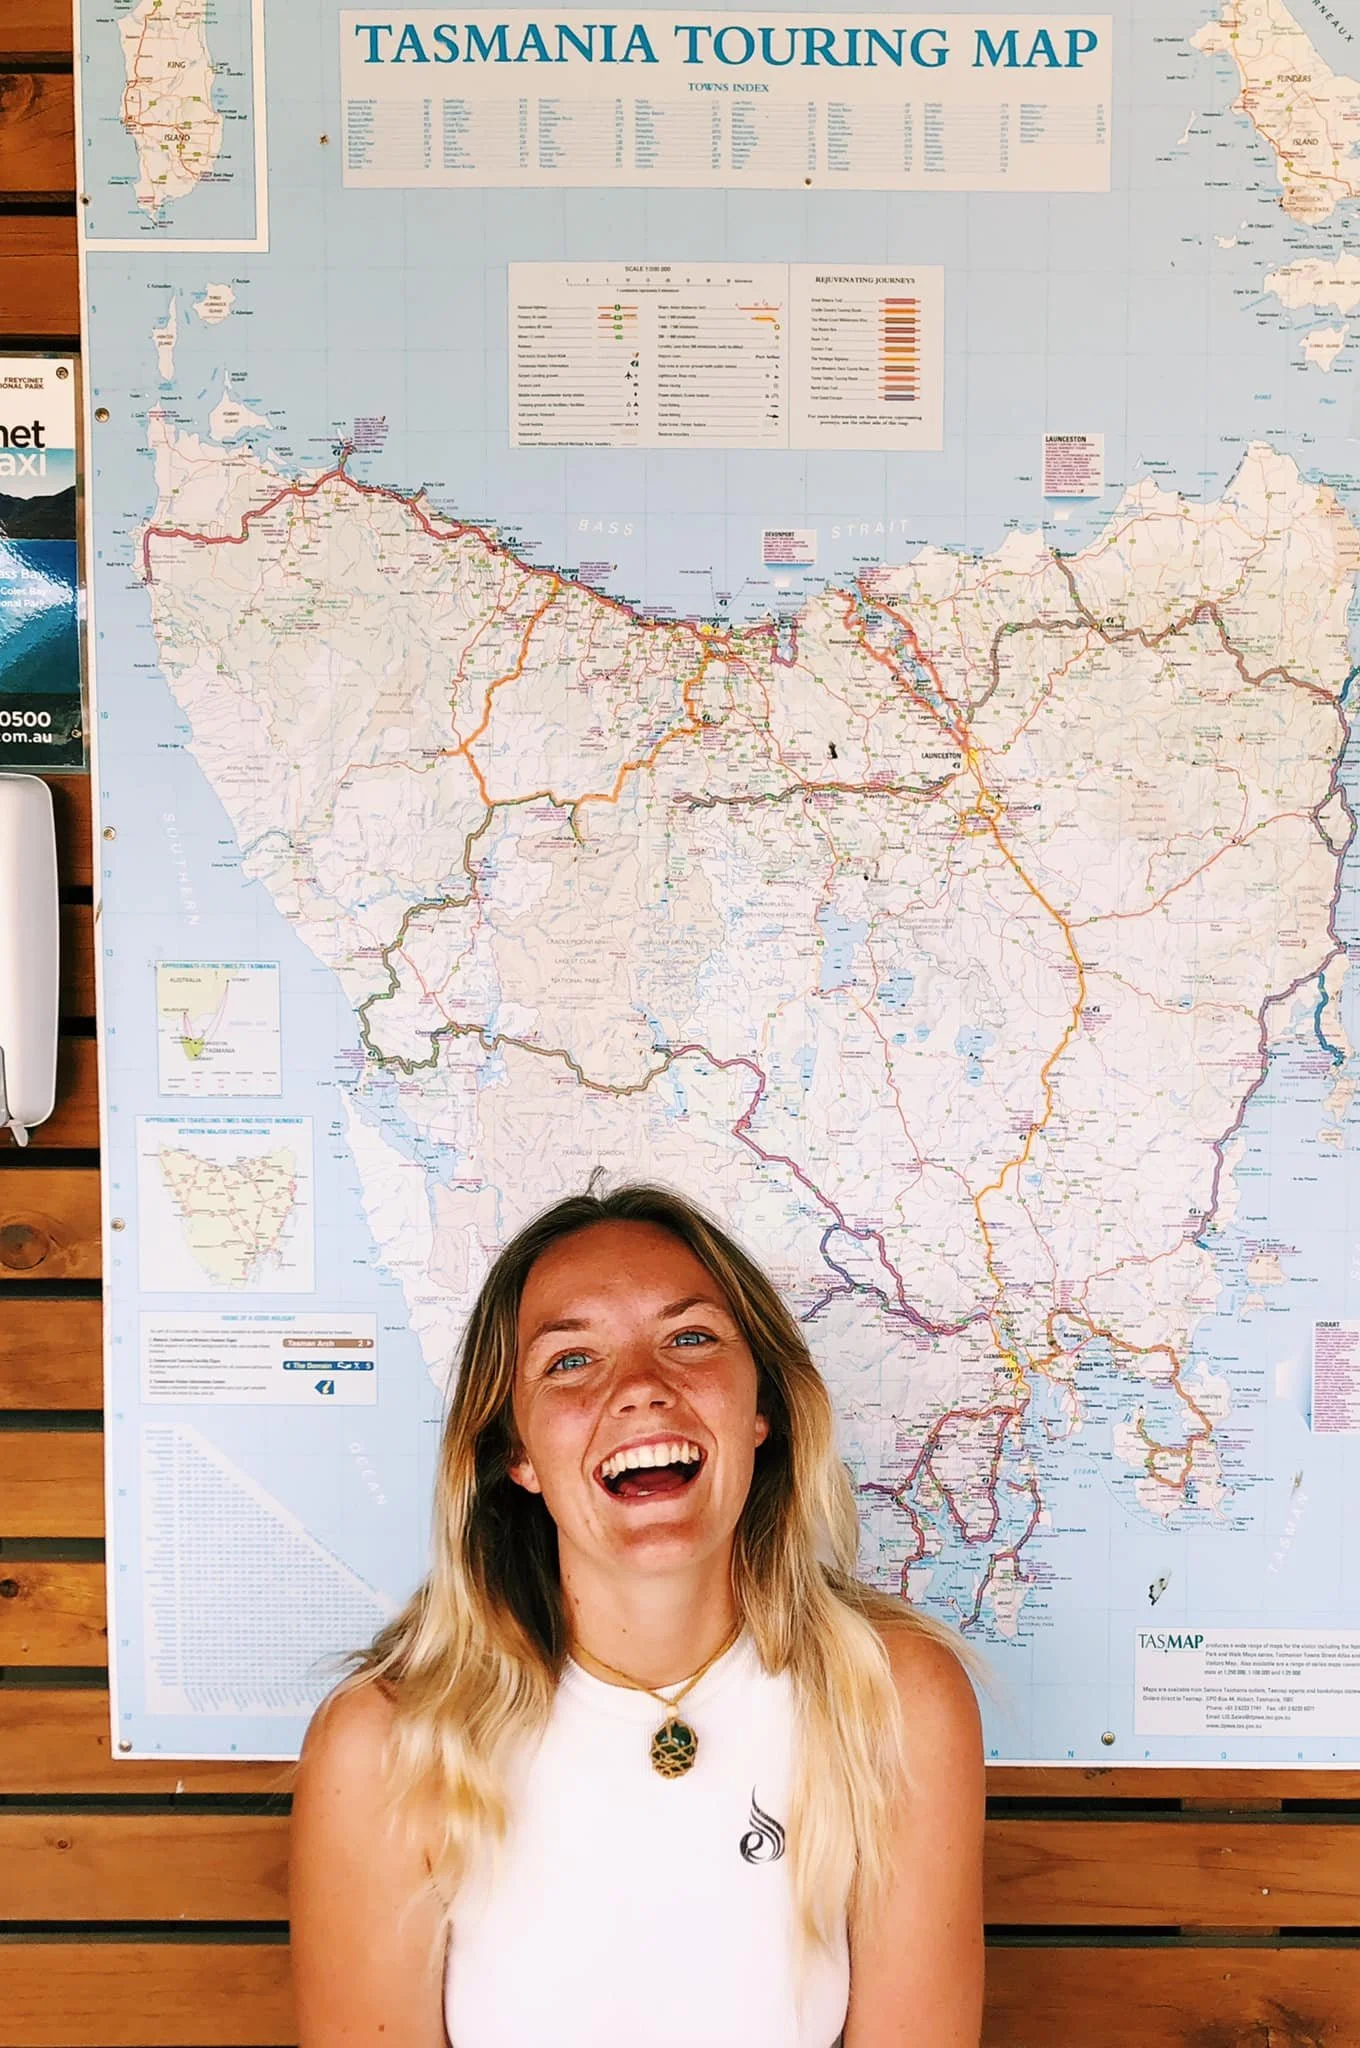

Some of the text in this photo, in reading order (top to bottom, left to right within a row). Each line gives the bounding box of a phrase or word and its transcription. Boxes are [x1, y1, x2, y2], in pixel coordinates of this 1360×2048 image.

[355, 24, 1098, 68] TASMANIA TOURING MAP
[167, 61, 186, 69] KING
[1277, 75, 1311, 83] FLINDERS
[688, 82, 770, 92] TOWNS INDEX
[1292, 138, 1319, 146] ISLAND
[815, 276, 873, 284] REJUVENATING
[0, 449, 47, 476] axi
[578, 519, 634, 536] BASS
[831, 519, 908, 539] STRAIT
[0, 711, 51, 727] 0500
[0, 732, 52, 743] om.au
[1137, 1634, 1204, 1649] TASMAP
